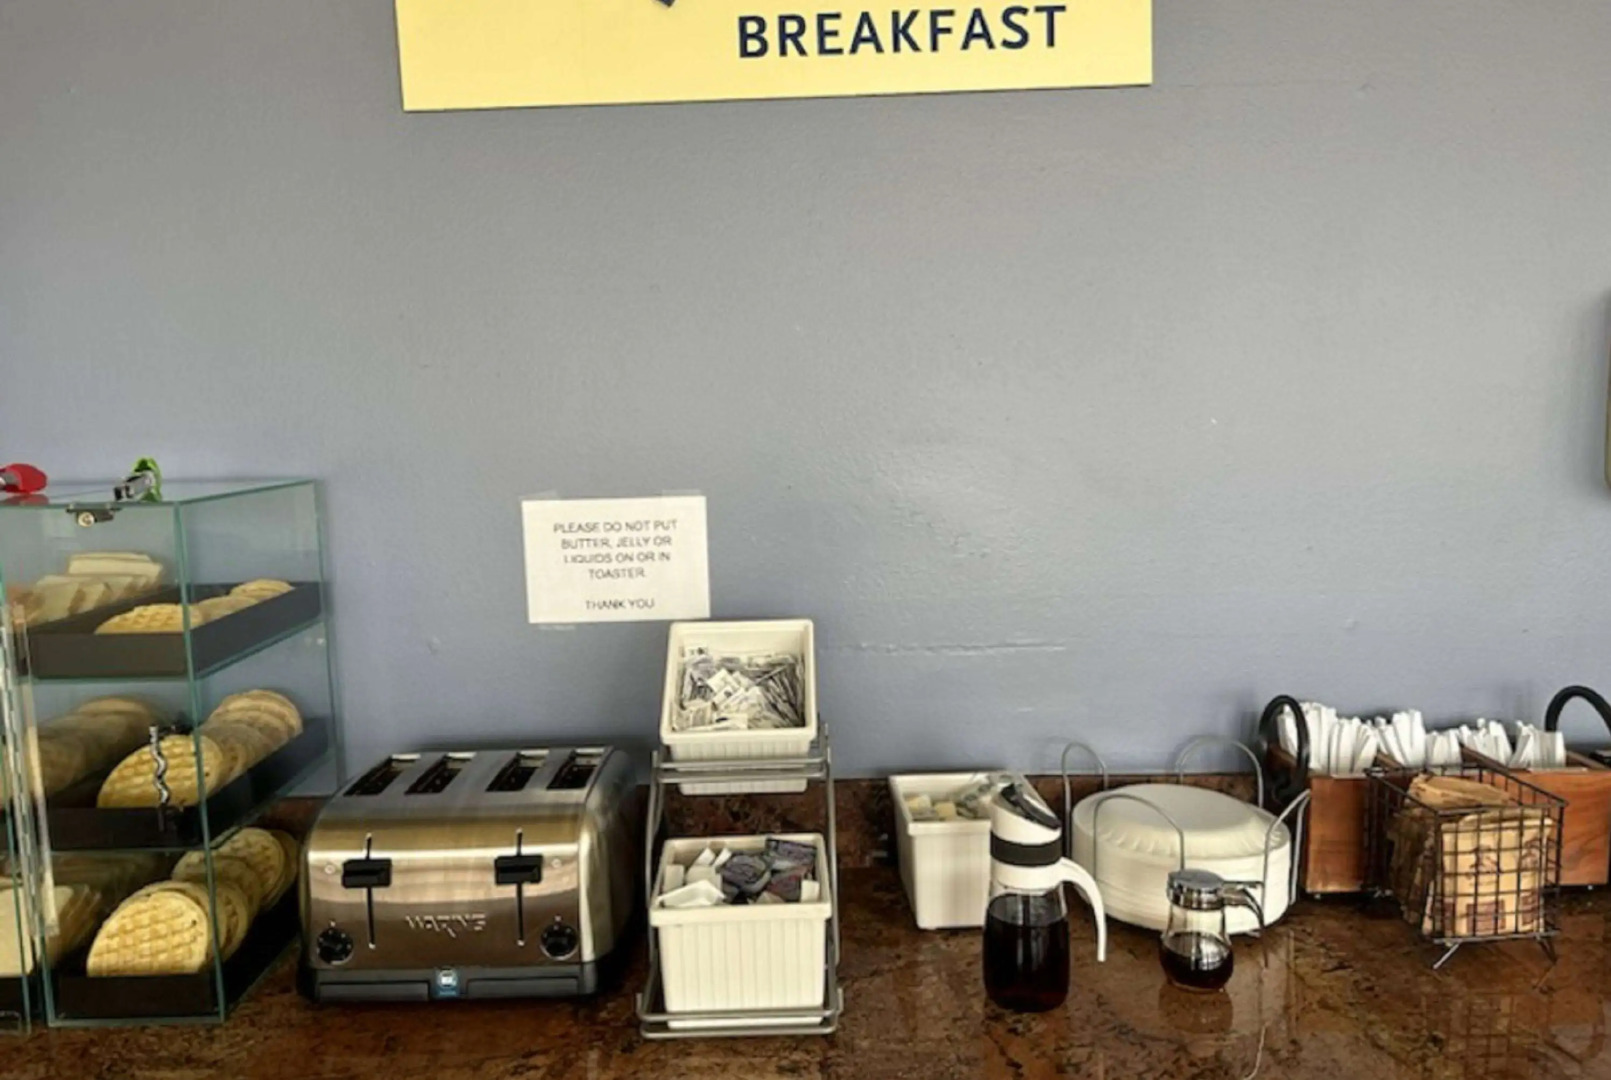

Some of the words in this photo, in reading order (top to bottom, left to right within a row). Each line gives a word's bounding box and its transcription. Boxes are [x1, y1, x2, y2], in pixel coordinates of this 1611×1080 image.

[738, 5, 1067, 58] BREAKFAST
[553, 522, 600, 534] PLEASE
[603, 521, 622, 532] DO
[625, 520, 650, 532] NOT
[653, 519, 678, 531] PUT
[616, 536, 650, 548] JELLY
[653, 535, 672, 547] OR
[564, 552, 612, 564] LIQUIDS
[615, 552, 634, 563] ON
[636, 551, 655, 562] OR
[658, 551, 671, 561] IN
[586, 599, 626, 610] THANK
[628, 598, 656, 609] YOU
